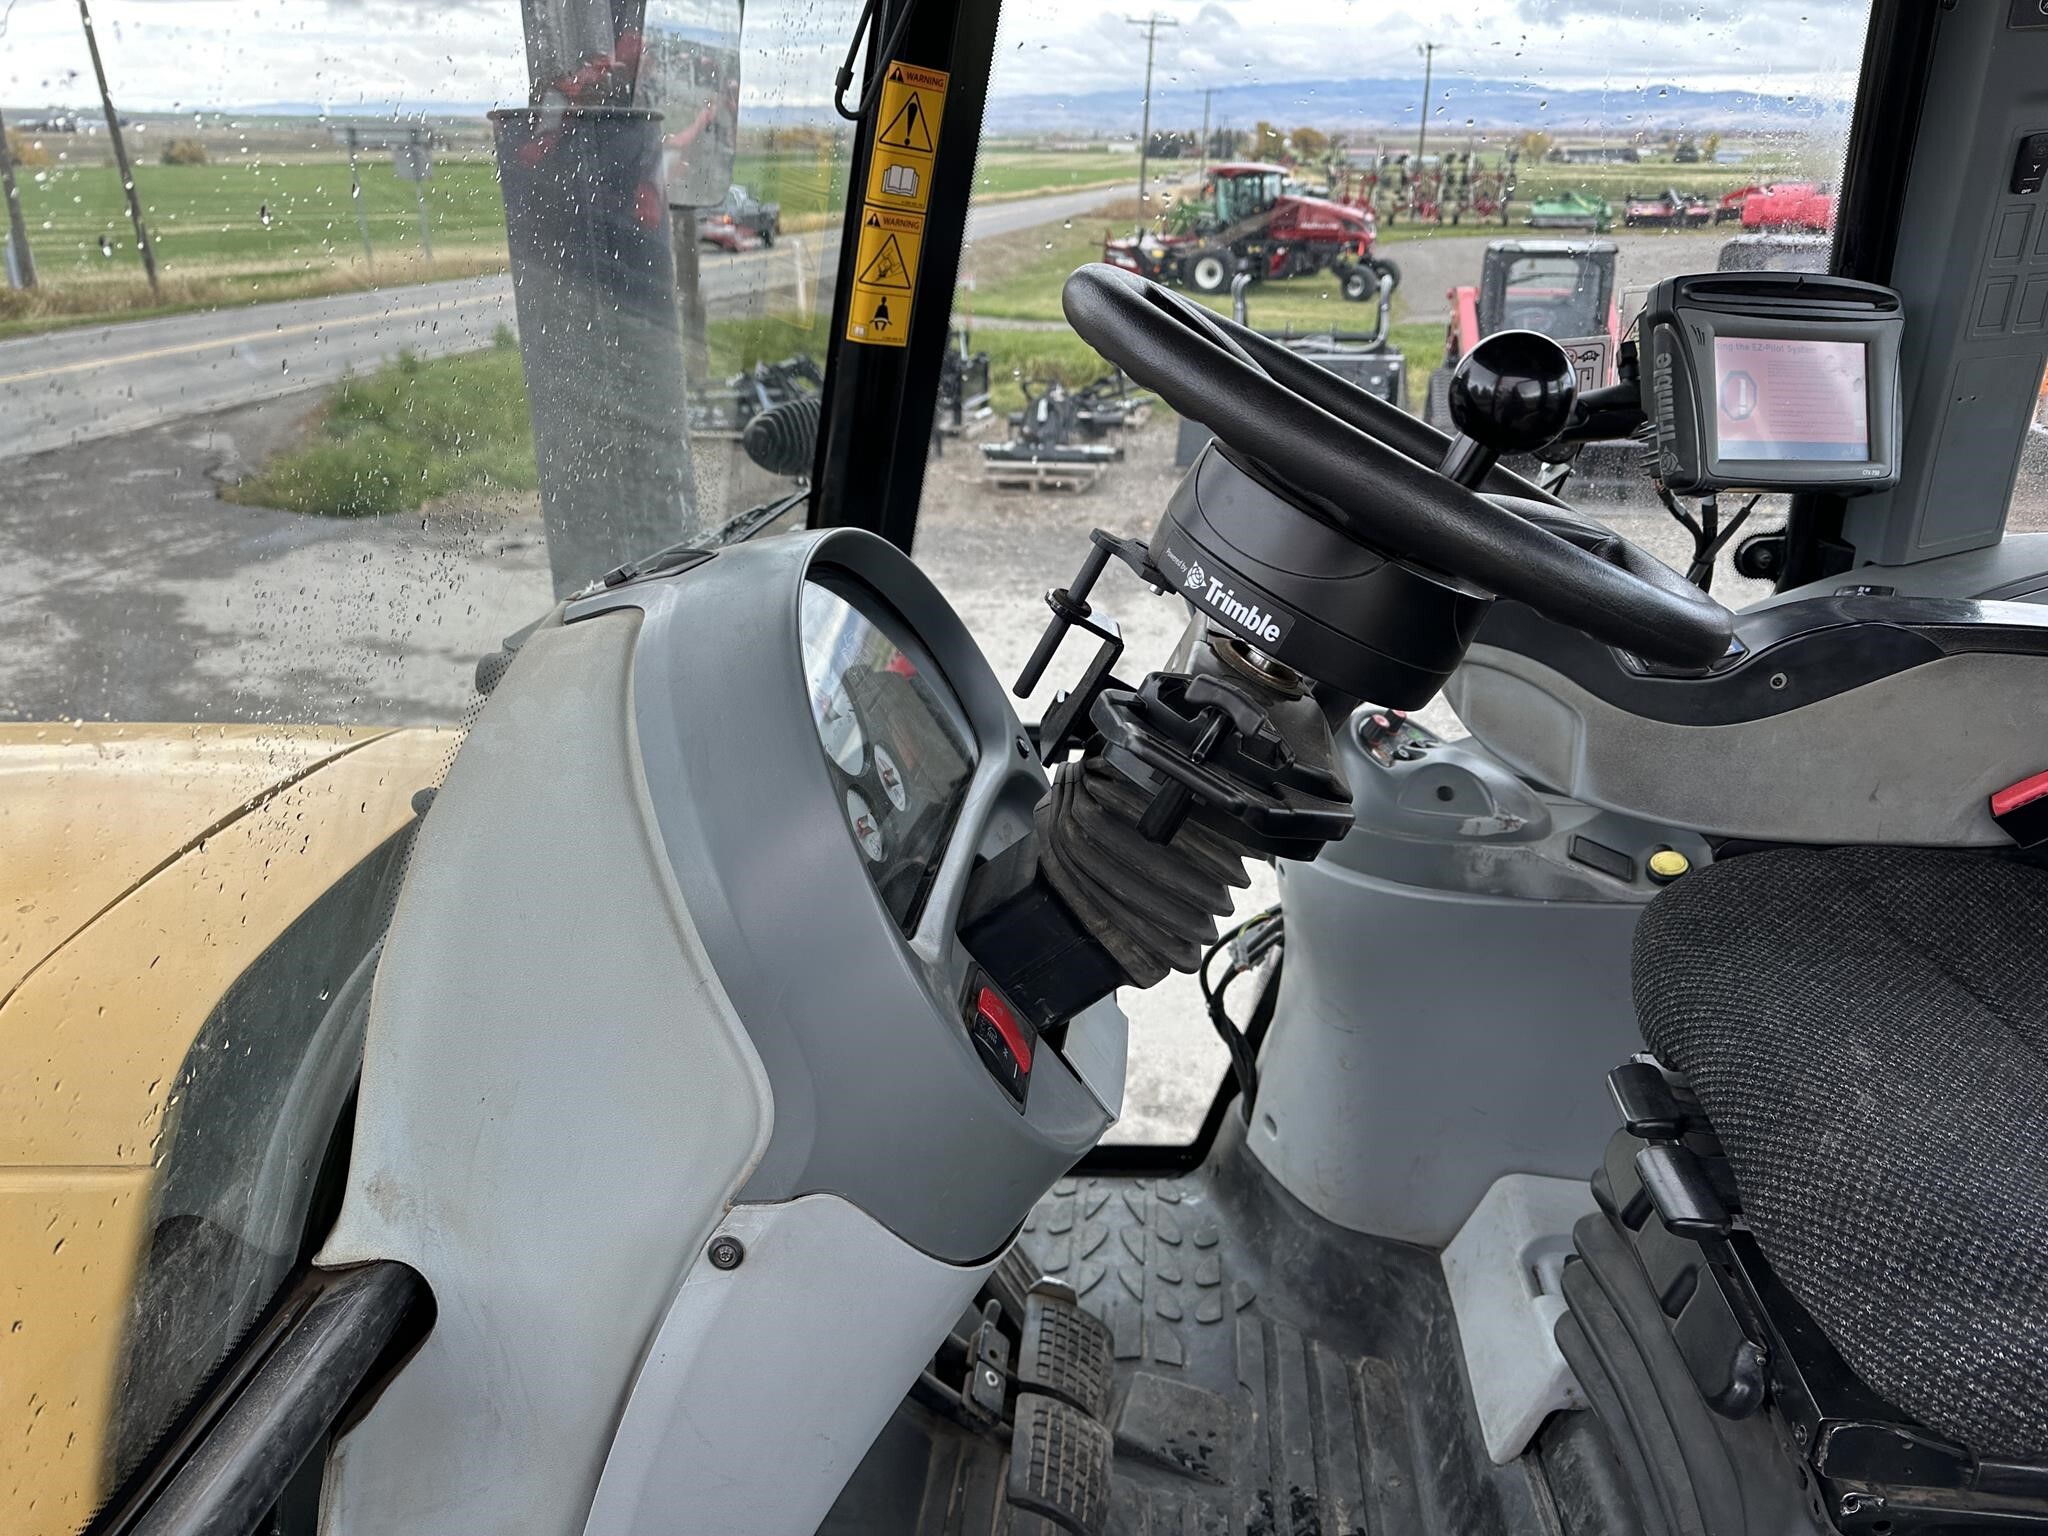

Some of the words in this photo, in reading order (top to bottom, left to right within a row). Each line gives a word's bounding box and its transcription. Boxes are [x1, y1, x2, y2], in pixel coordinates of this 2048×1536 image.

[906, 71, 945, 88] WARNING
[882, 216, 920, 230] WARNING
[1736, 342, 1749, 351] the
[1653, 352, 1676, 442] Trimble
[1204, 576, 1281, 643] Trimble
